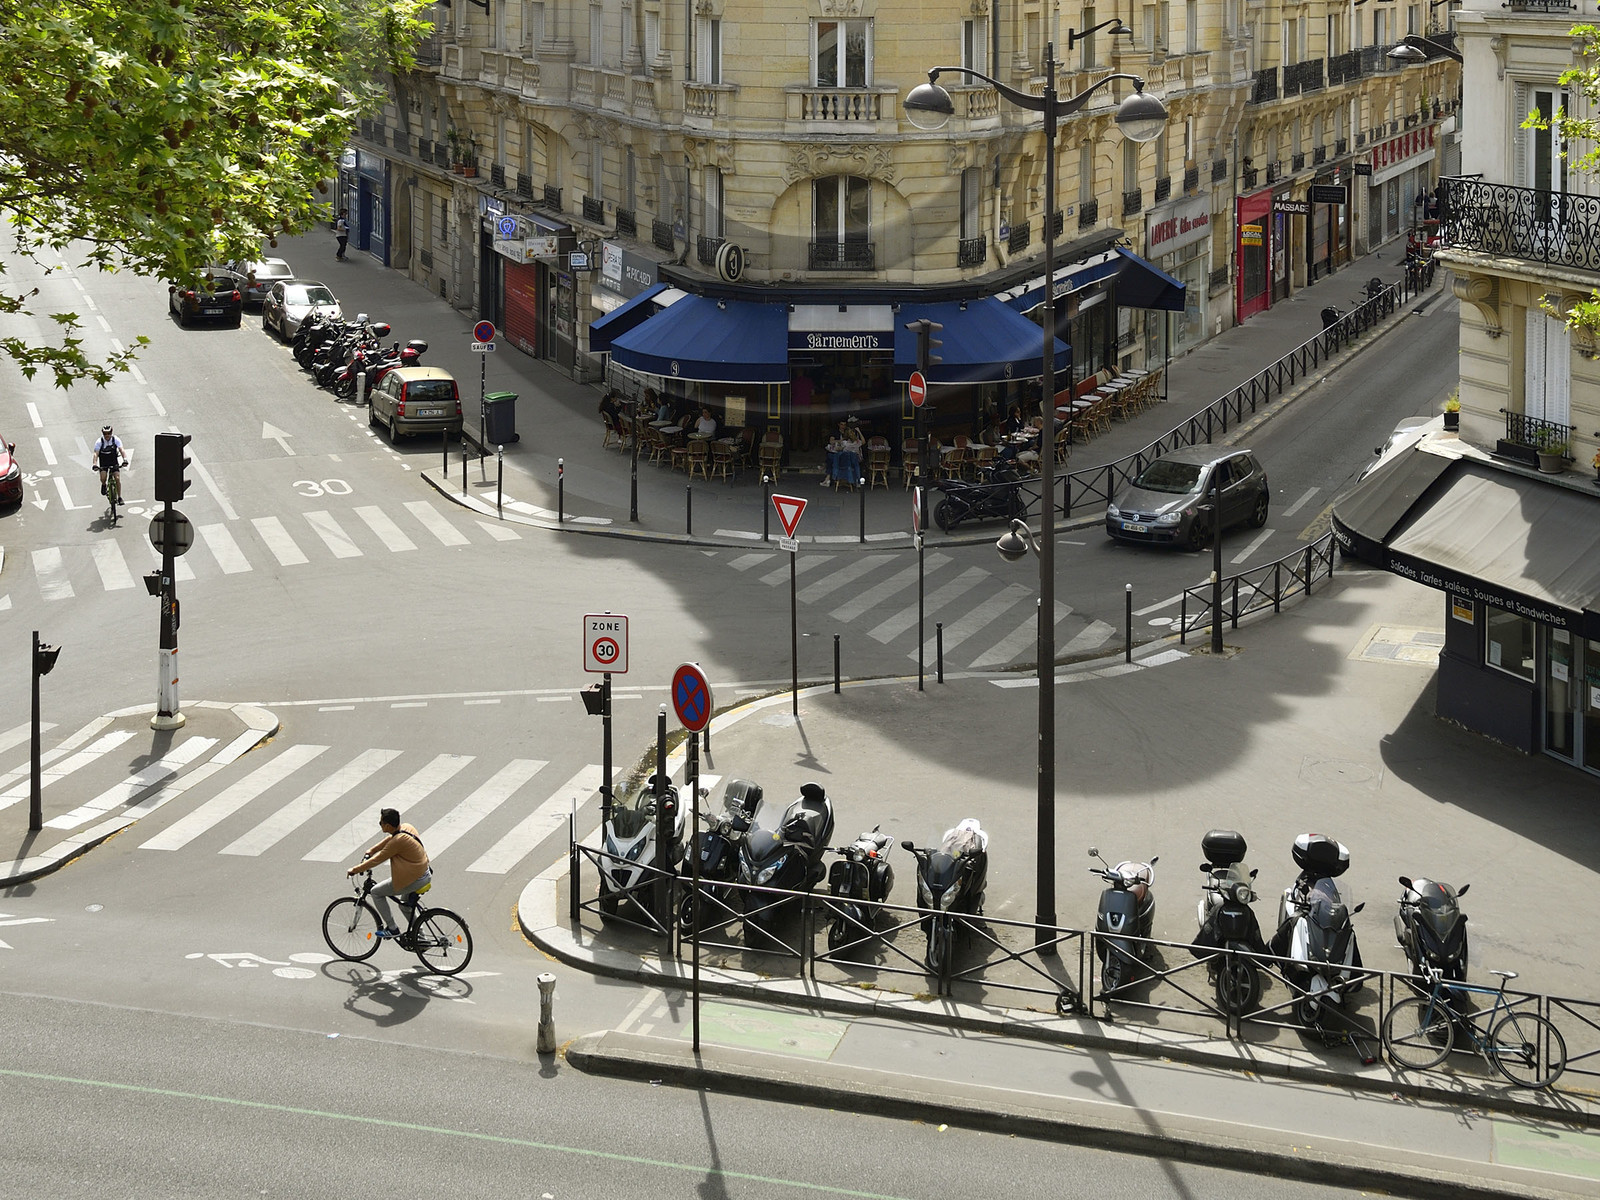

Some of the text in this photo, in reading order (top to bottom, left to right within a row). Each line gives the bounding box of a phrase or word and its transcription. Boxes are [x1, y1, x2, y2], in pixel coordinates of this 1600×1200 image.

[1273, 202, 1310, 213] MASSAGE
[1151, 216, 1179, 247] LAVERIE
[292, 478, 354, 498] 30
[1390, 559, 1567, 627] Salades, Tartes salées, Soupes et Sandwiches
[592, 622, 620, 631] ZONE
[598, 644, 615, 657] 30
